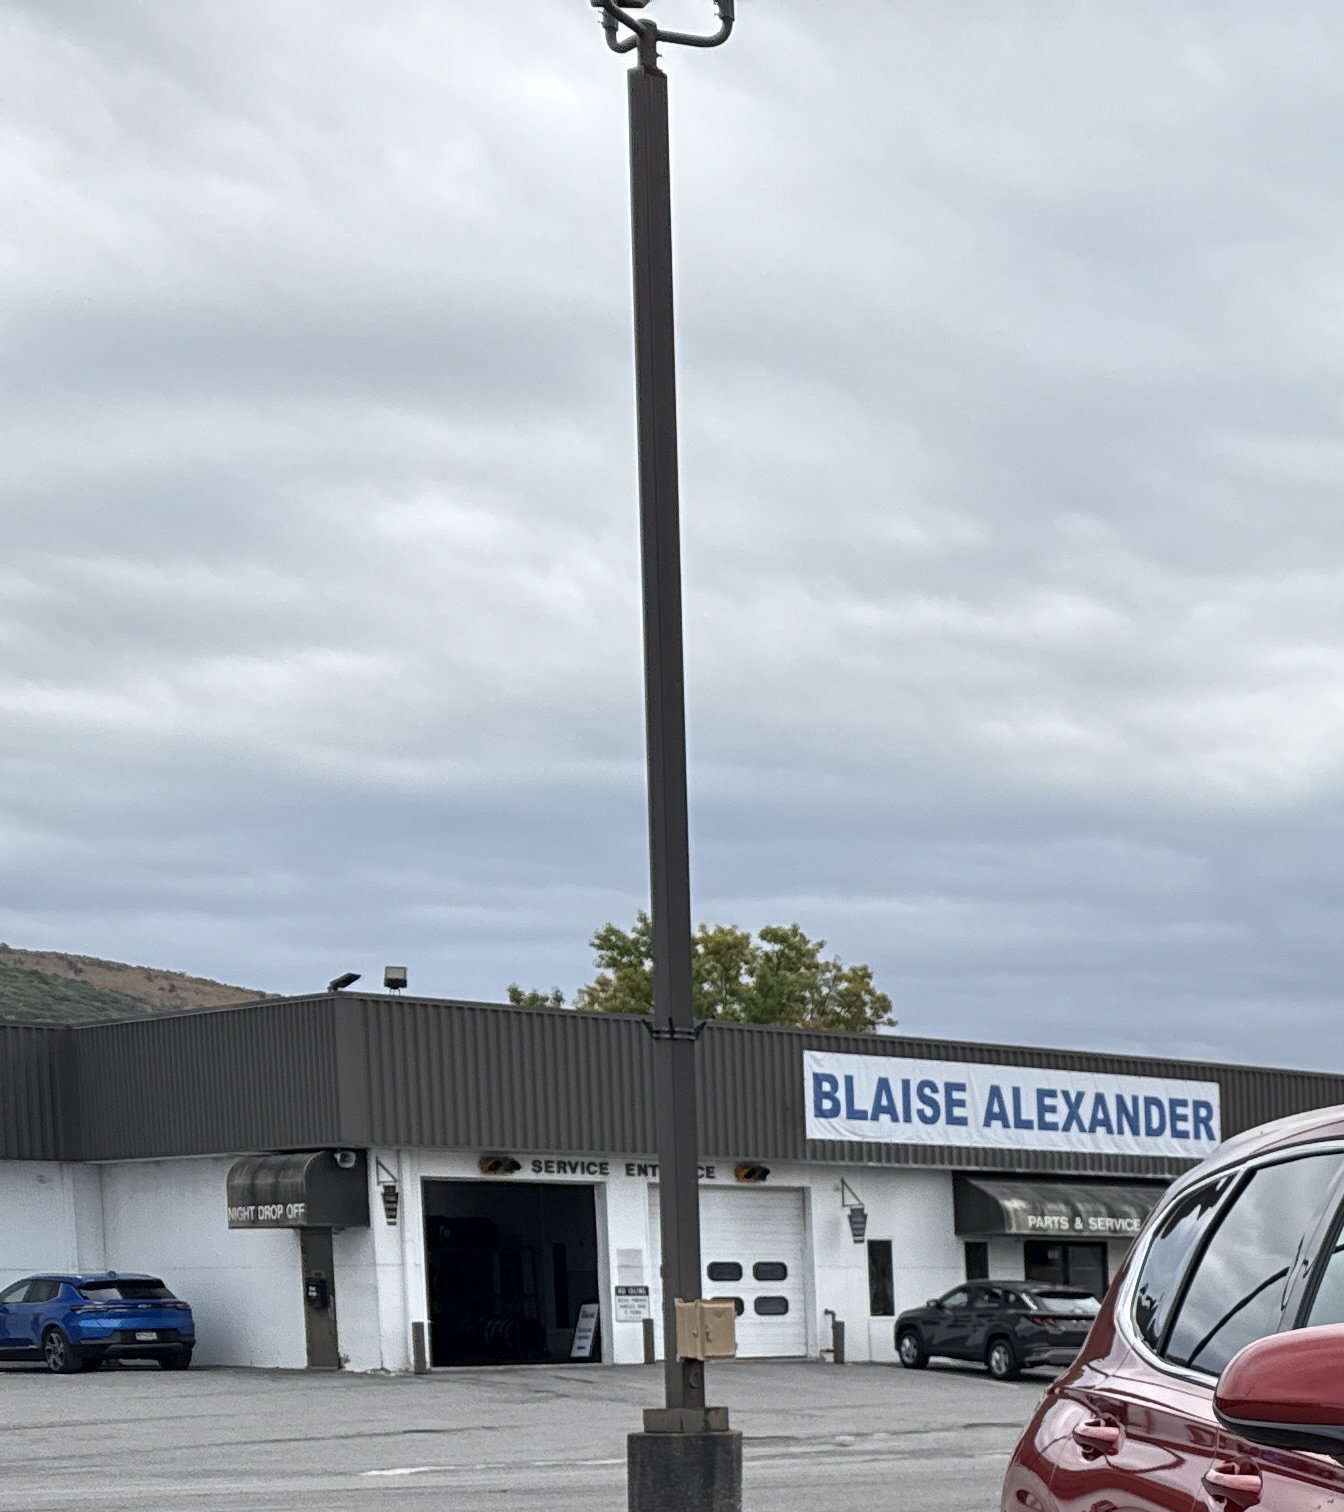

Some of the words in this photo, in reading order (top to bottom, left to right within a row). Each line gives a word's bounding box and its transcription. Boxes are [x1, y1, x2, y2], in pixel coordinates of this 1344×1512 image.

[812, 1071, 968, 1127] BLAISE
[983, 1084, 1217, 1142] ALEXANDER
[531, 1159, 610, 1176] SERVICE
[228, 1206, 256, 1221] NIGHT
[258, 1204, 283, 1220] DROP
[285, 1202, 305, 1219] OFF
[1027, 1215, 1070, 1230] PARTS
[1074, 1217, 1084, 1230] &
[1088, 1217, 1141, 1231] SERVICE
